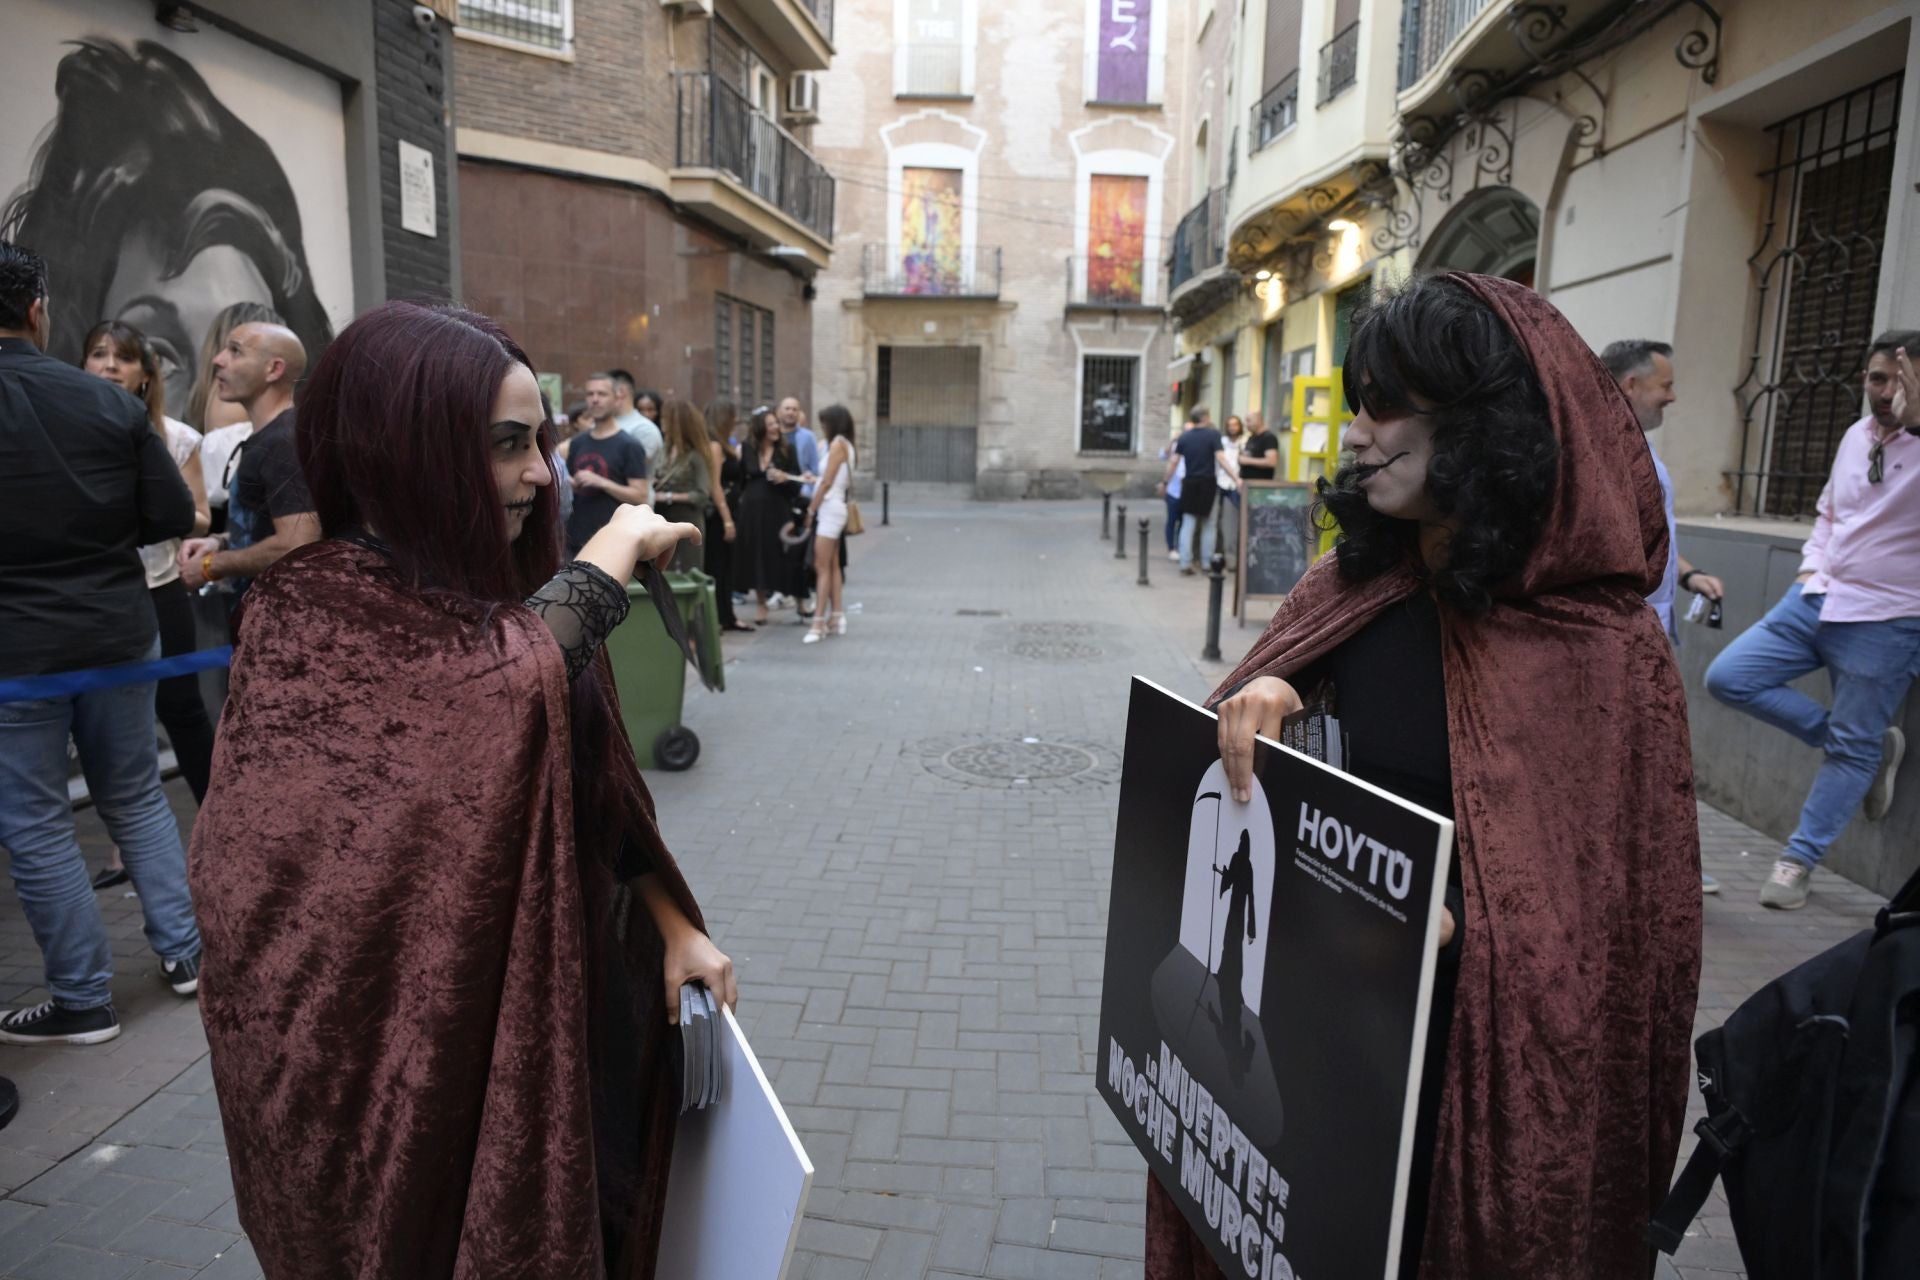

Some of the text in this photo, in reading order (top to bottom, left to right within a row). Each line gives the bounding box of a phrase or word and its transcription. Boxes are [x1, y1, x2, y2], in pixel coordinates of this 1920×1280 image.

[1107, 1035, 1177, 1165] NOCHE
[1158, 1039, 1269, 1216] MUERTE
[1268, 1165, 1290, 1210] DE
